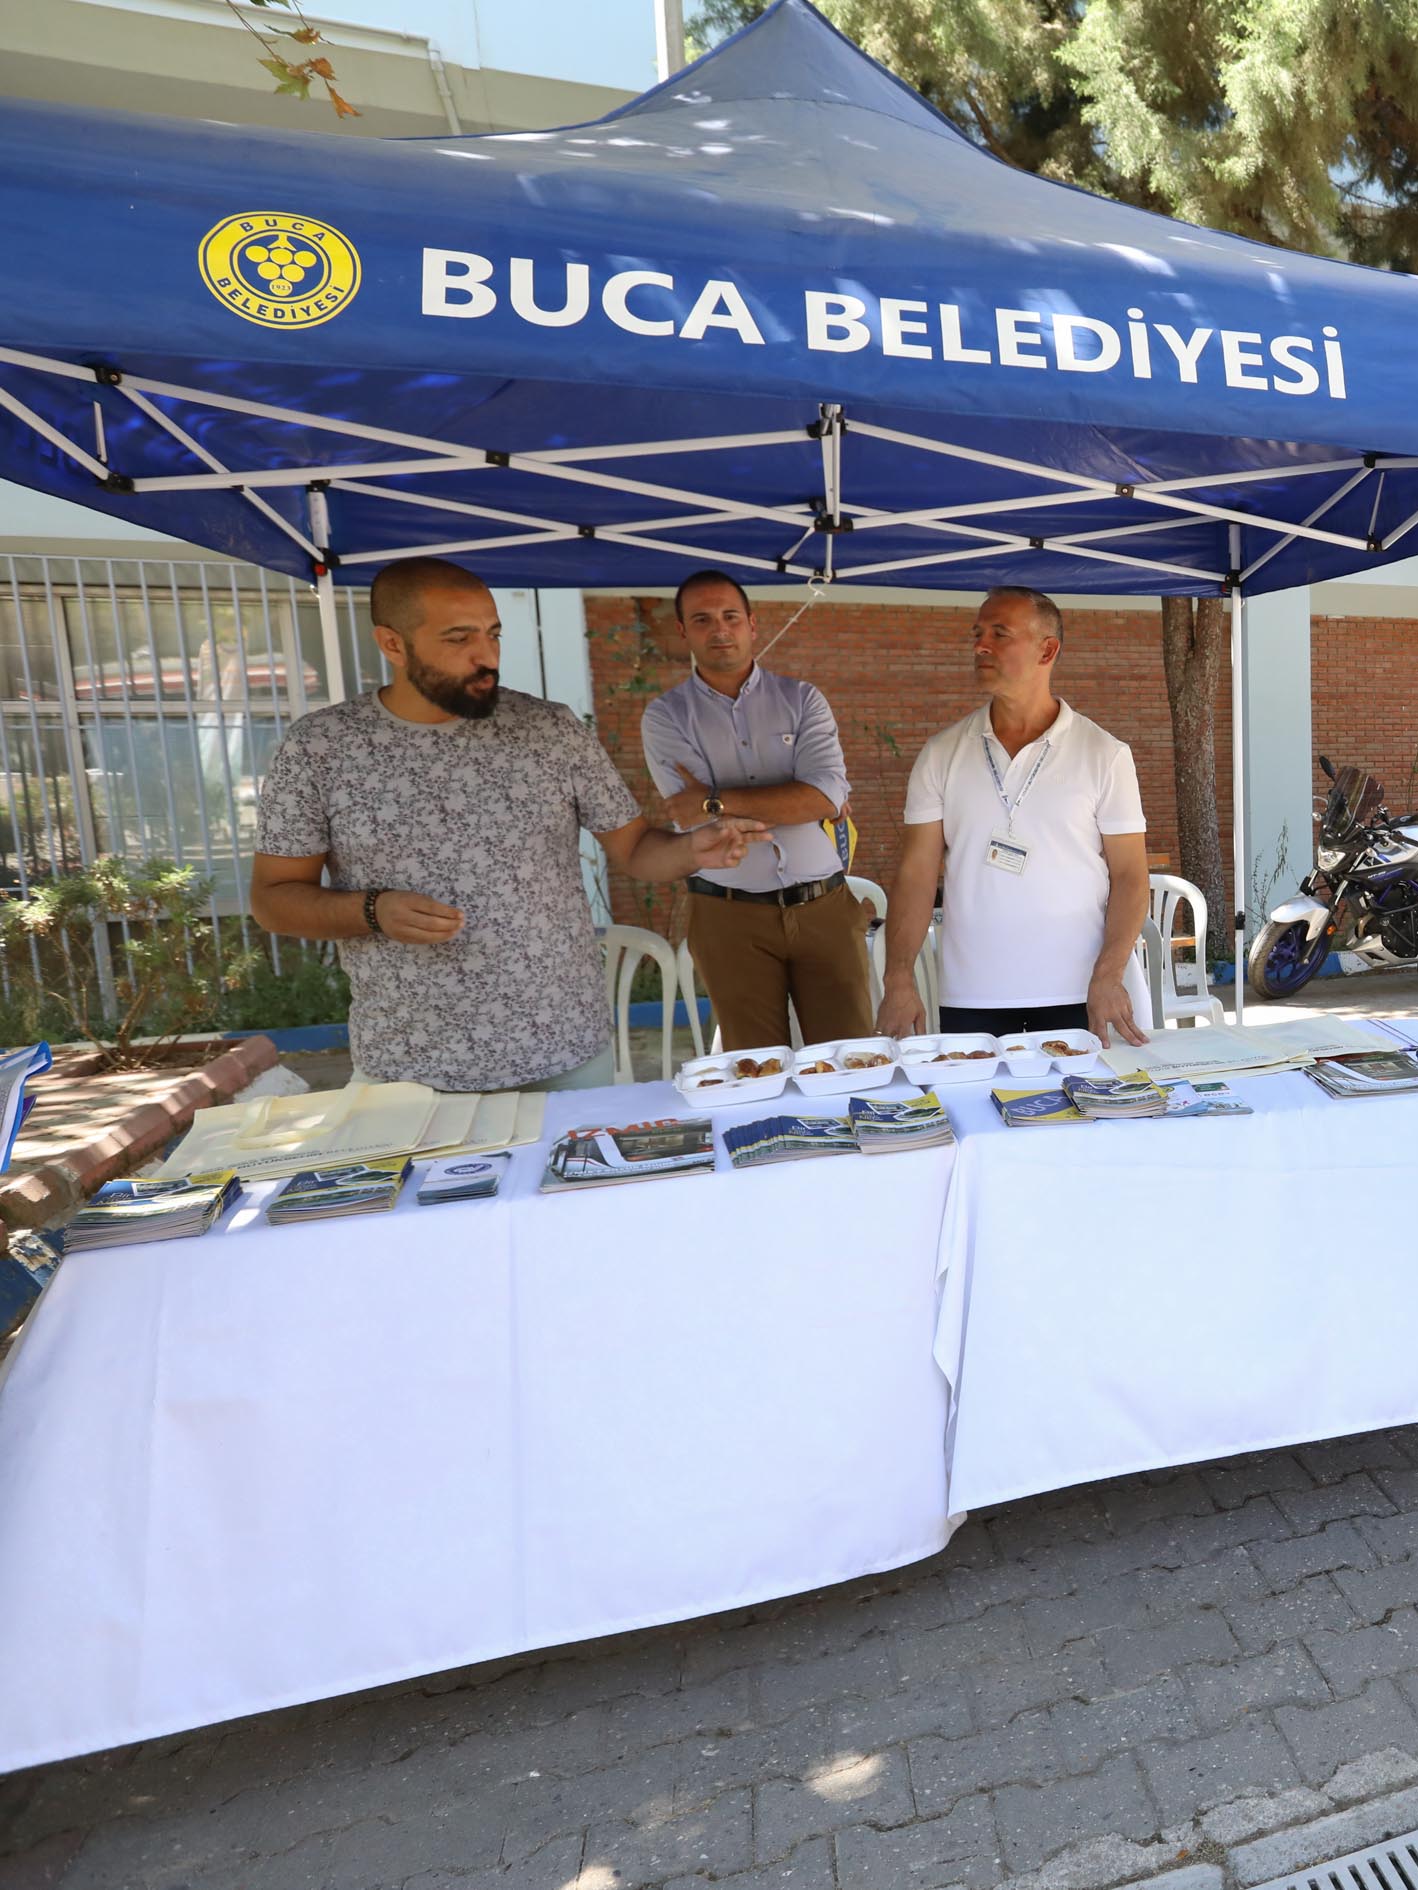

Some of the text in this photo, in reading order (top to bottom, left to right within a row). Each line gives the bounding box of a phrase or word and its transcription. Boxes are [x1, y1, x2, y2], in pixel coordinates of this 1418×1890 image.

[239, 217, 326, 241] BUCA
[216, 276, 345, 319] BELEDİYESİ
[271, 284, 291, 292] 1923
[421, 247, 1348, 399] BUCA BELEDİYESİ
[1009, 1094, 1065, 1116] BUCA
